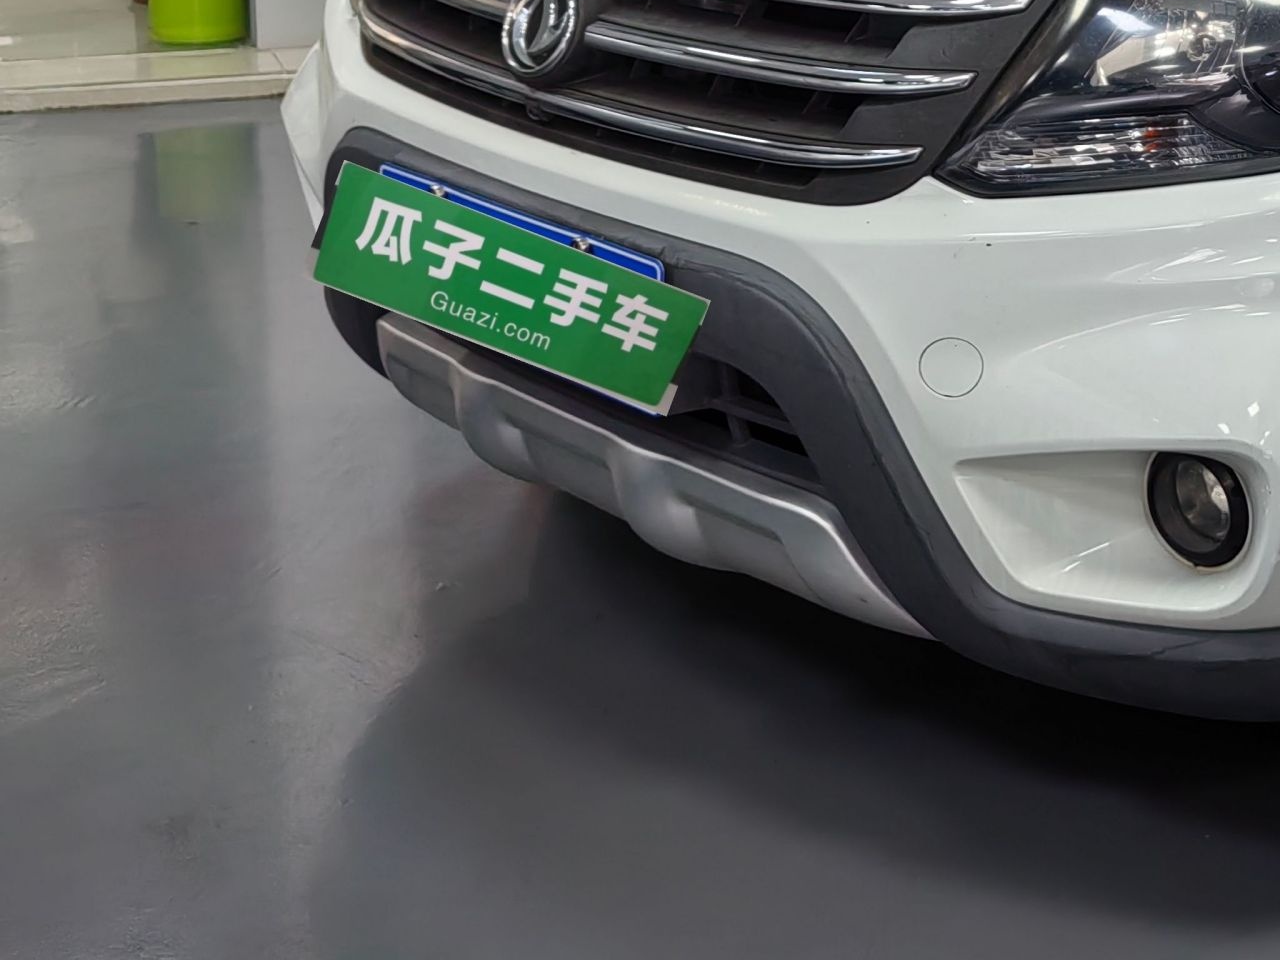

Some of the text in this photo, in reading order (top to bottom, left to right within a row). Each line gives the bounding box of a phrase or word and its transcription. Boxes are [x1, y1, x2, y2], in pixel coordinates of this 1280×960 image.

[355, 196, 670, 353] 瓜子二手车
[429, 290, 552, 351] Guazi.com
